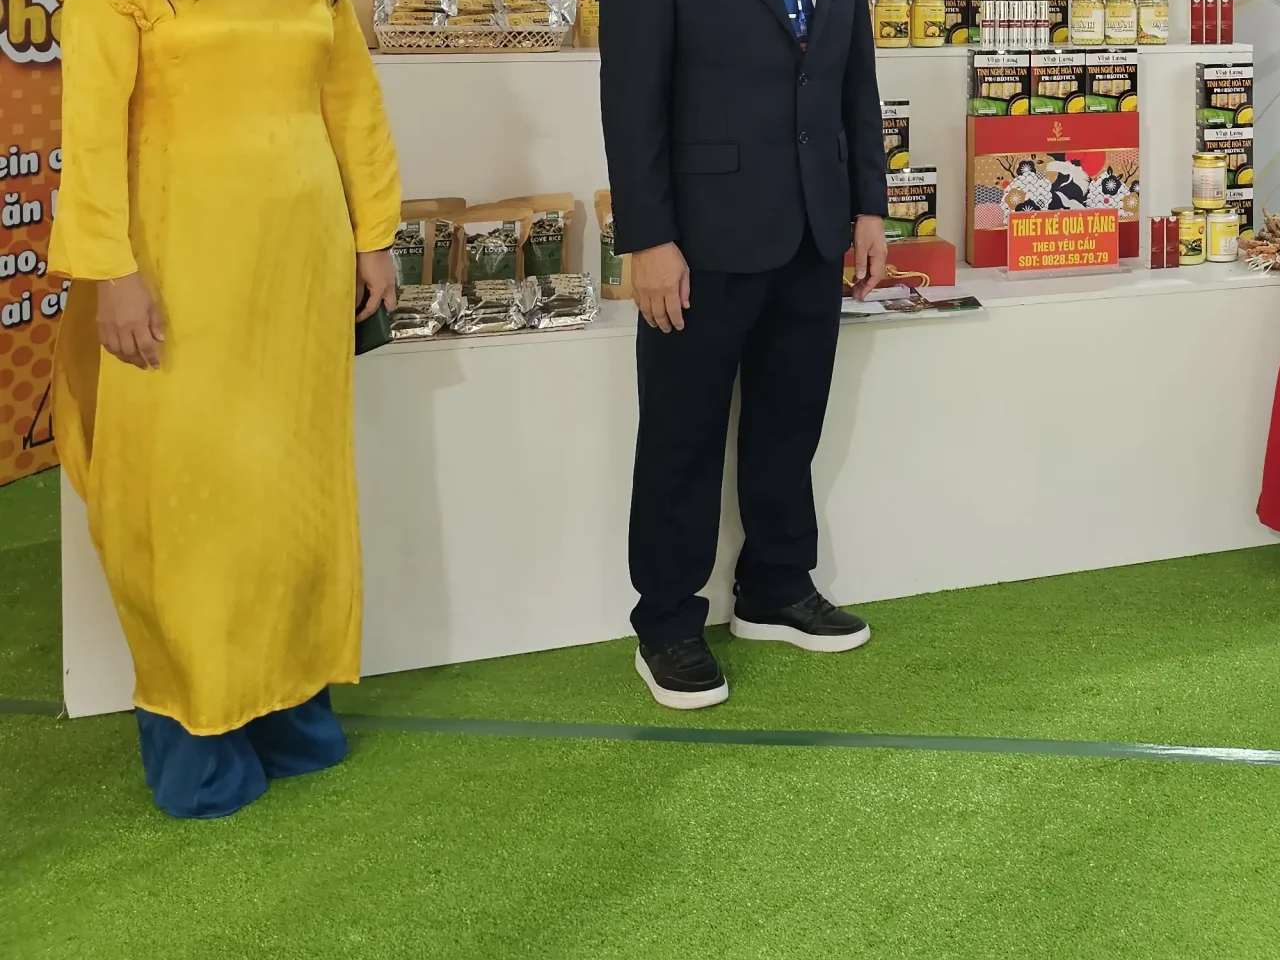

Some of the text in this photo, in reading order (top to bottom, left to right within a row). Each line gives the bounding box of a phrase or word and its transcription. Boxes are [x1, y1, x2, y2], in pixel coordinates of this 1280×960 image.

[1012, 212, 1115, 236] THIẾT KẾ QUÀ TẶNG
[1033, 241, 1055, 252] THEO
[1058, 239, 1075, 251] YÊU
[1043, 252, 1109, 266] 0828.59.79.79
